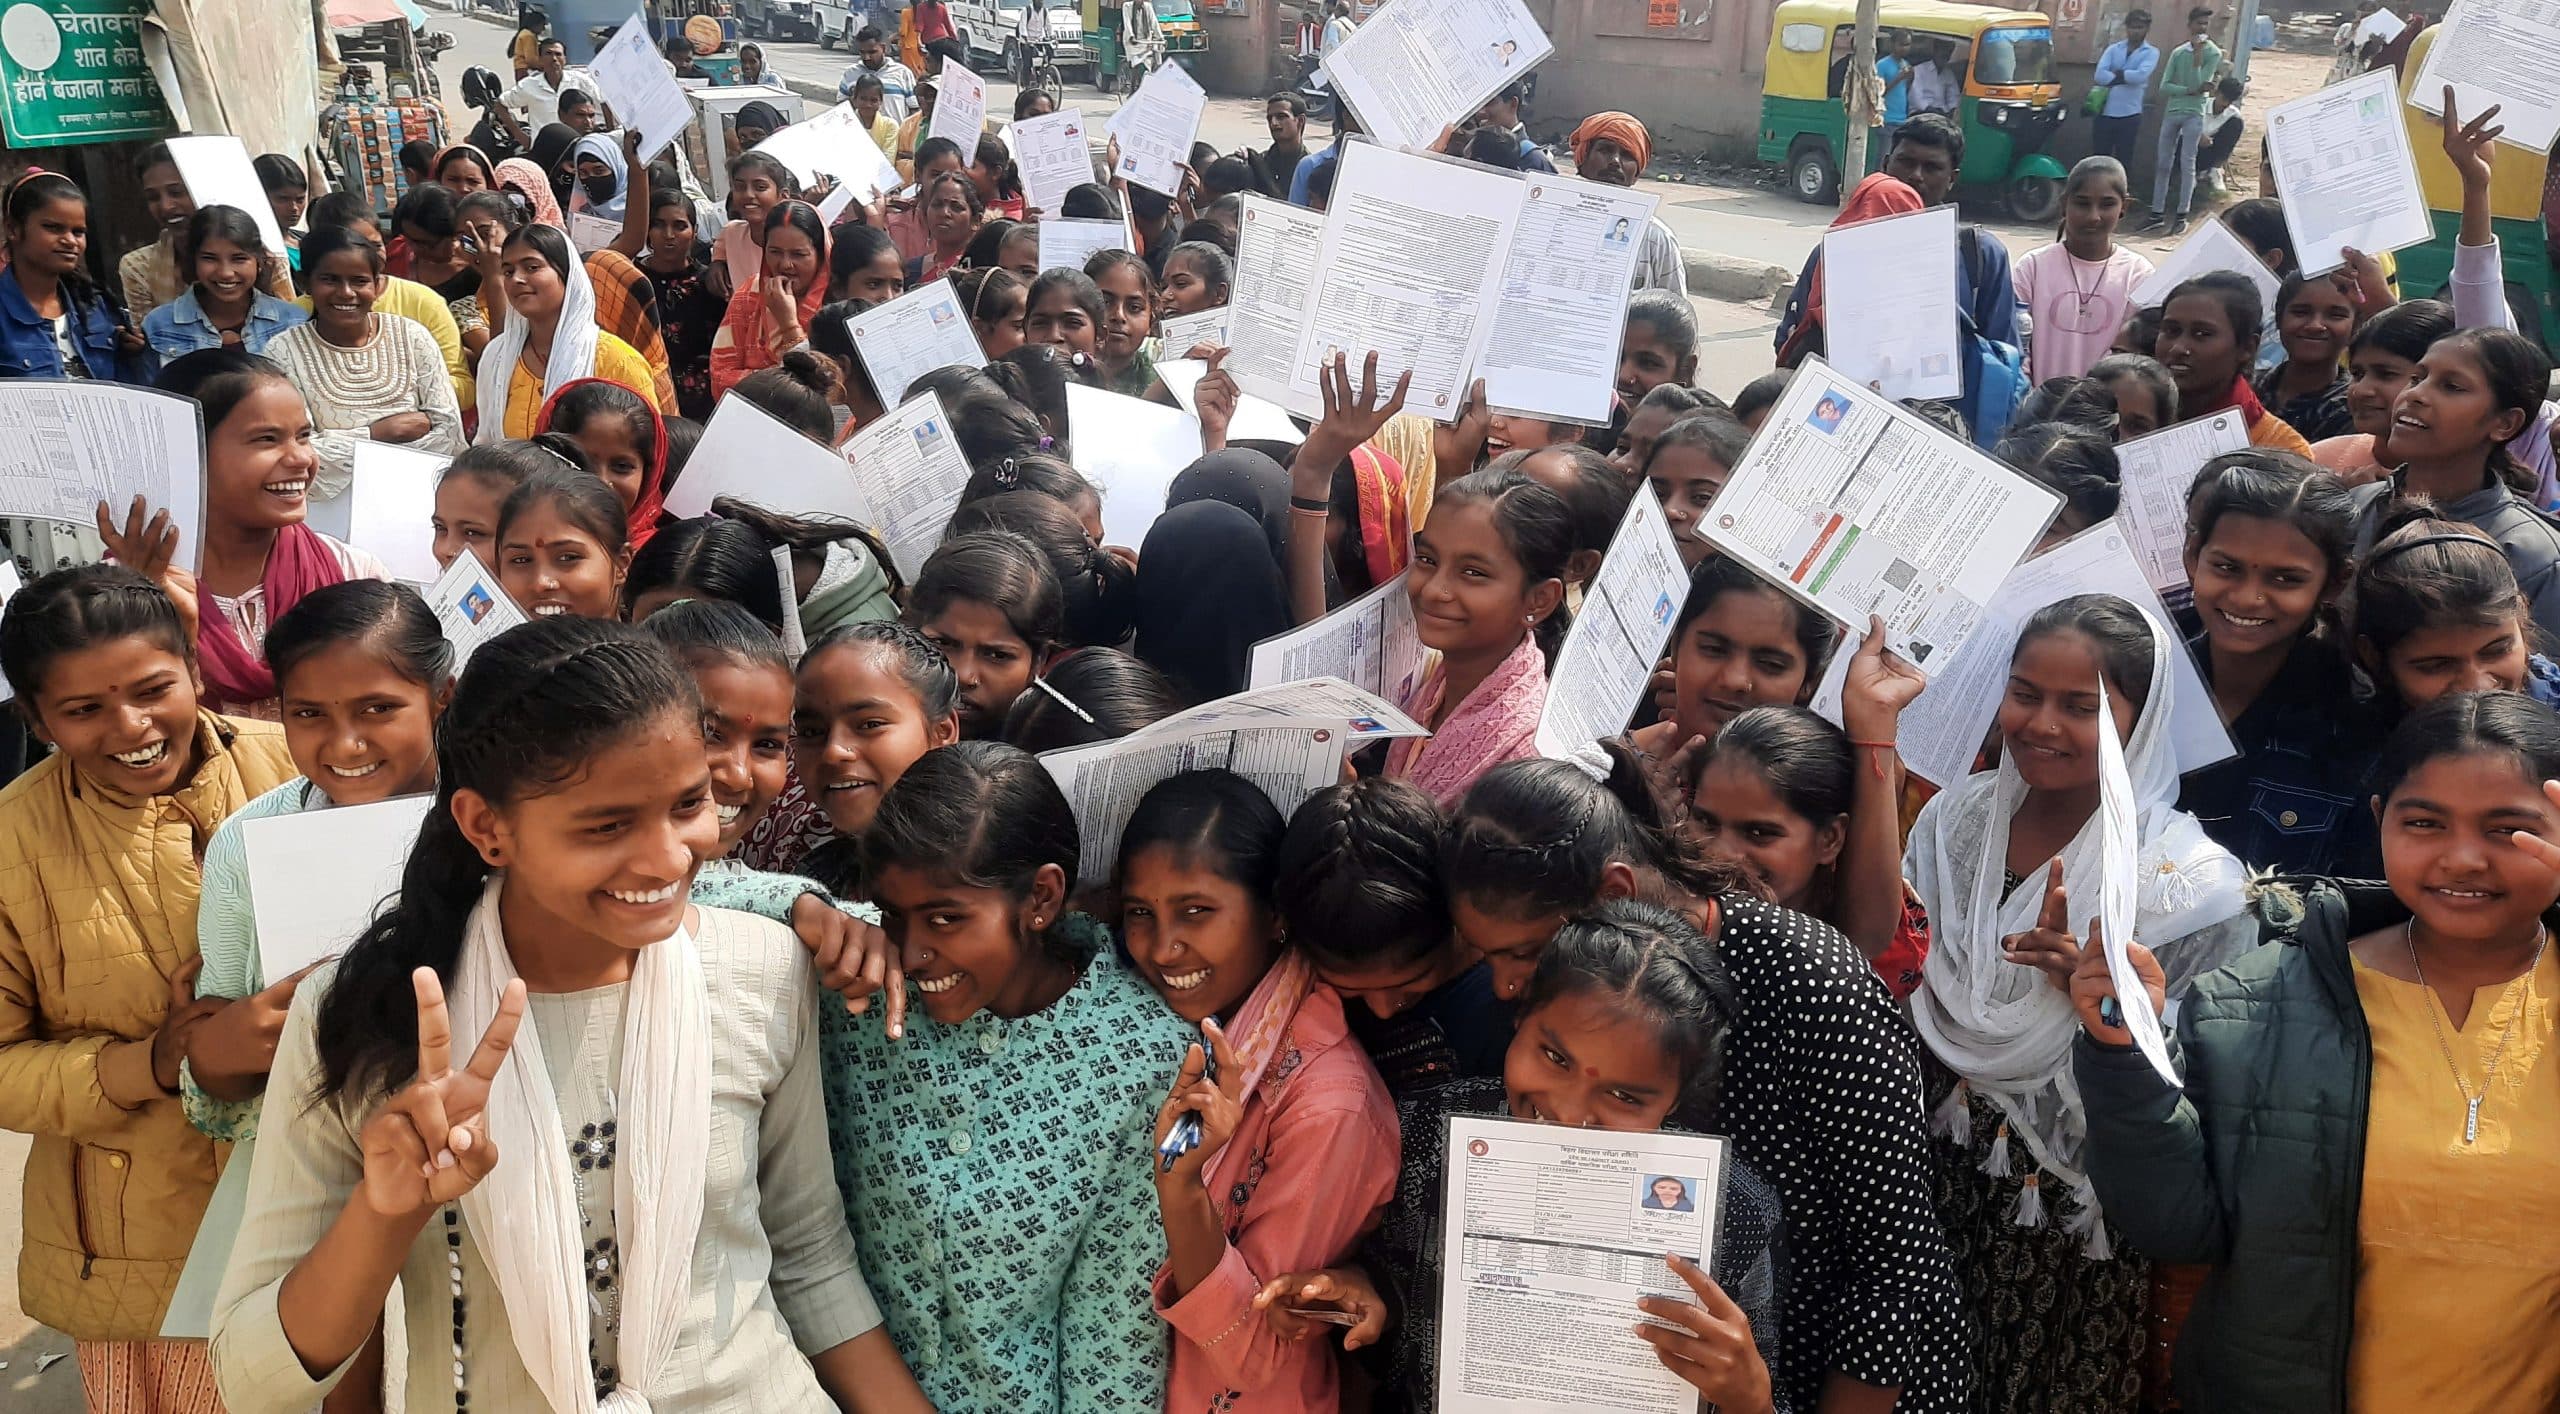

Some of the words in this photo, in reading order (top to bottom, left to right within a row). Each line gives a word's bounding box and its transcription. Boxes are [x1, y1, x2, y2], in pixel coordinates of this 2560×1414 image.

[74, 42, 108, 67] शांत
[113, 40, 141, 67] क्षेत्र
[13, 71, 47, 103] हॉर्न
[51, 79, 105, 100] बजाना
[110, 79, 142, 97] मना
